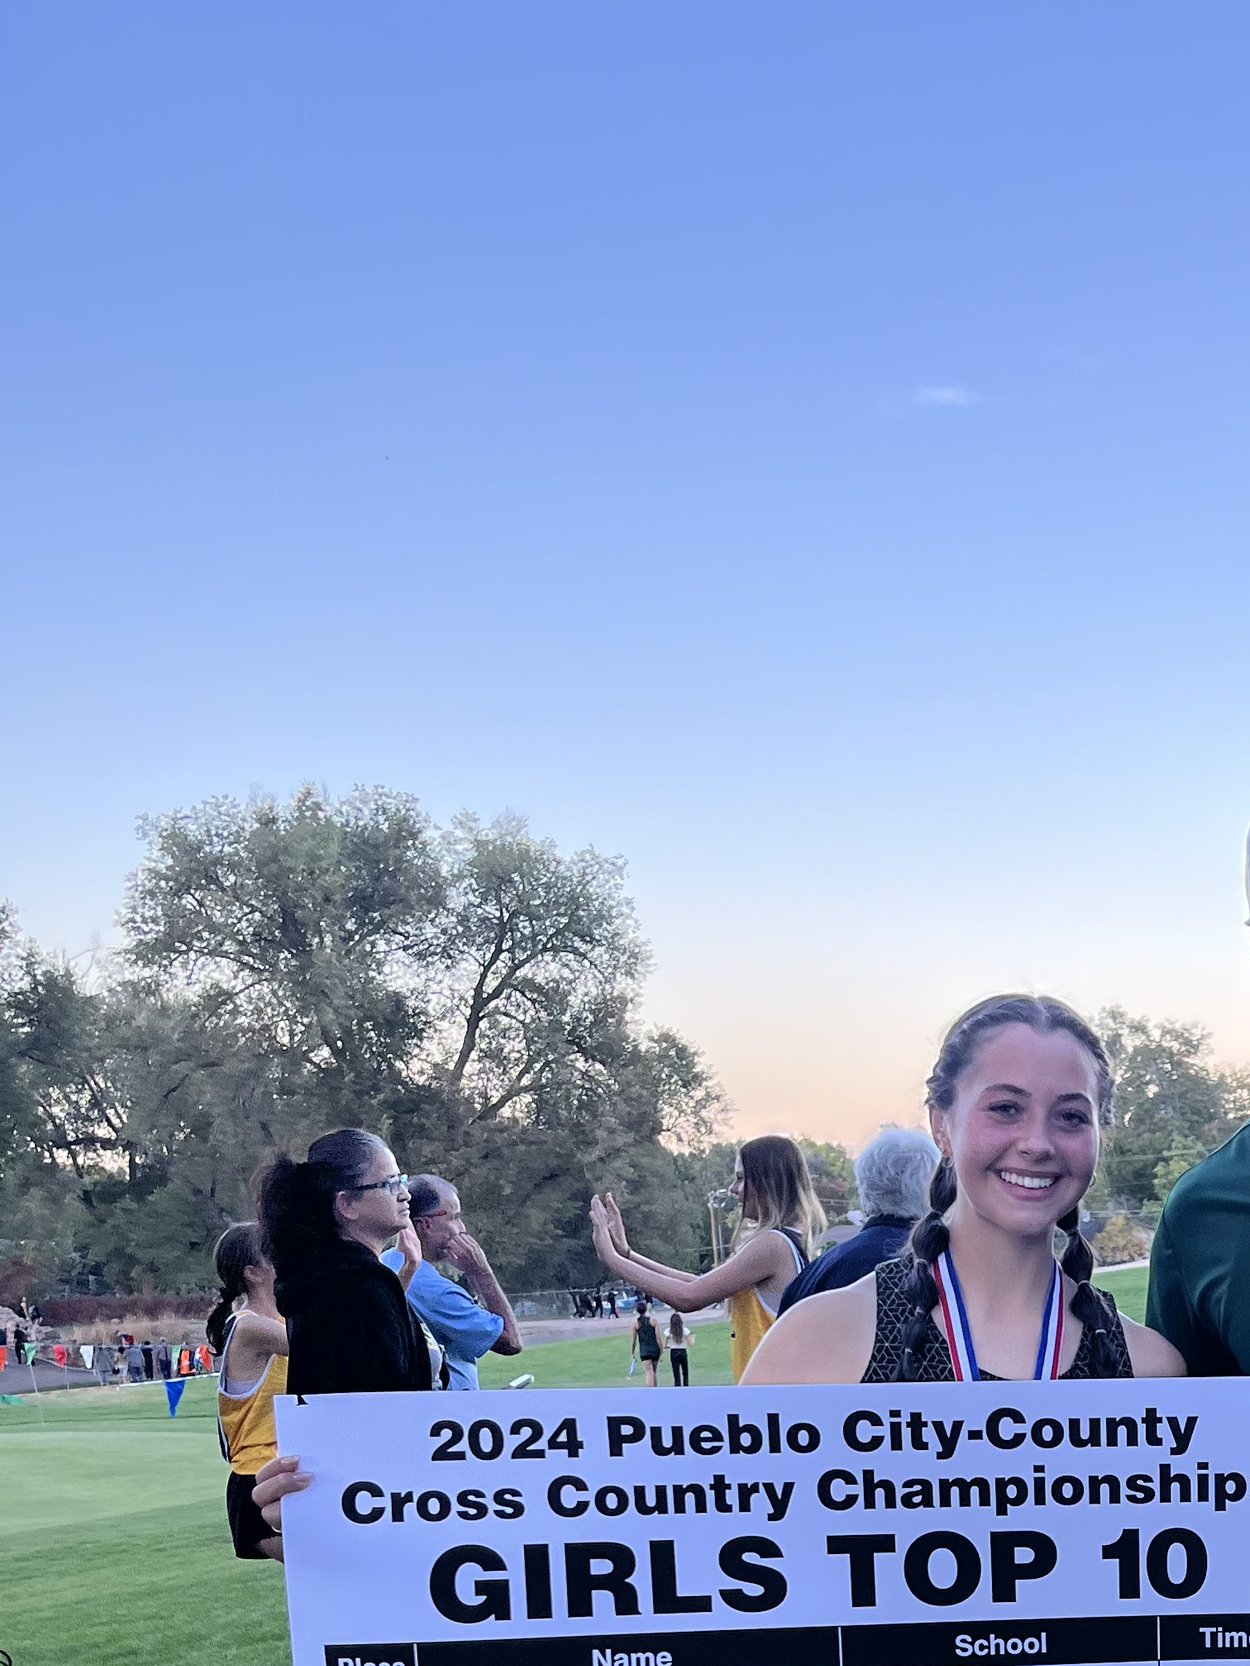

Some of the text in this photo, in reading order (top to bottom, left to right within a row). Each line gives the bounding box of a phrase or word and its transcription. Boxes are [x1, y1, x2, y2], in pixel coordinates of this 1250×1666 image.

[429, 1406, 1199, 1462] 2024 Pueblo City-County
[340, 1480, 525, 1525] Cross
[546, 1473, 796, 1522] Country
[429, 1526, 1208, 1625] GIRLS TOP 10
[954, 1632, 1047, 1658] School
